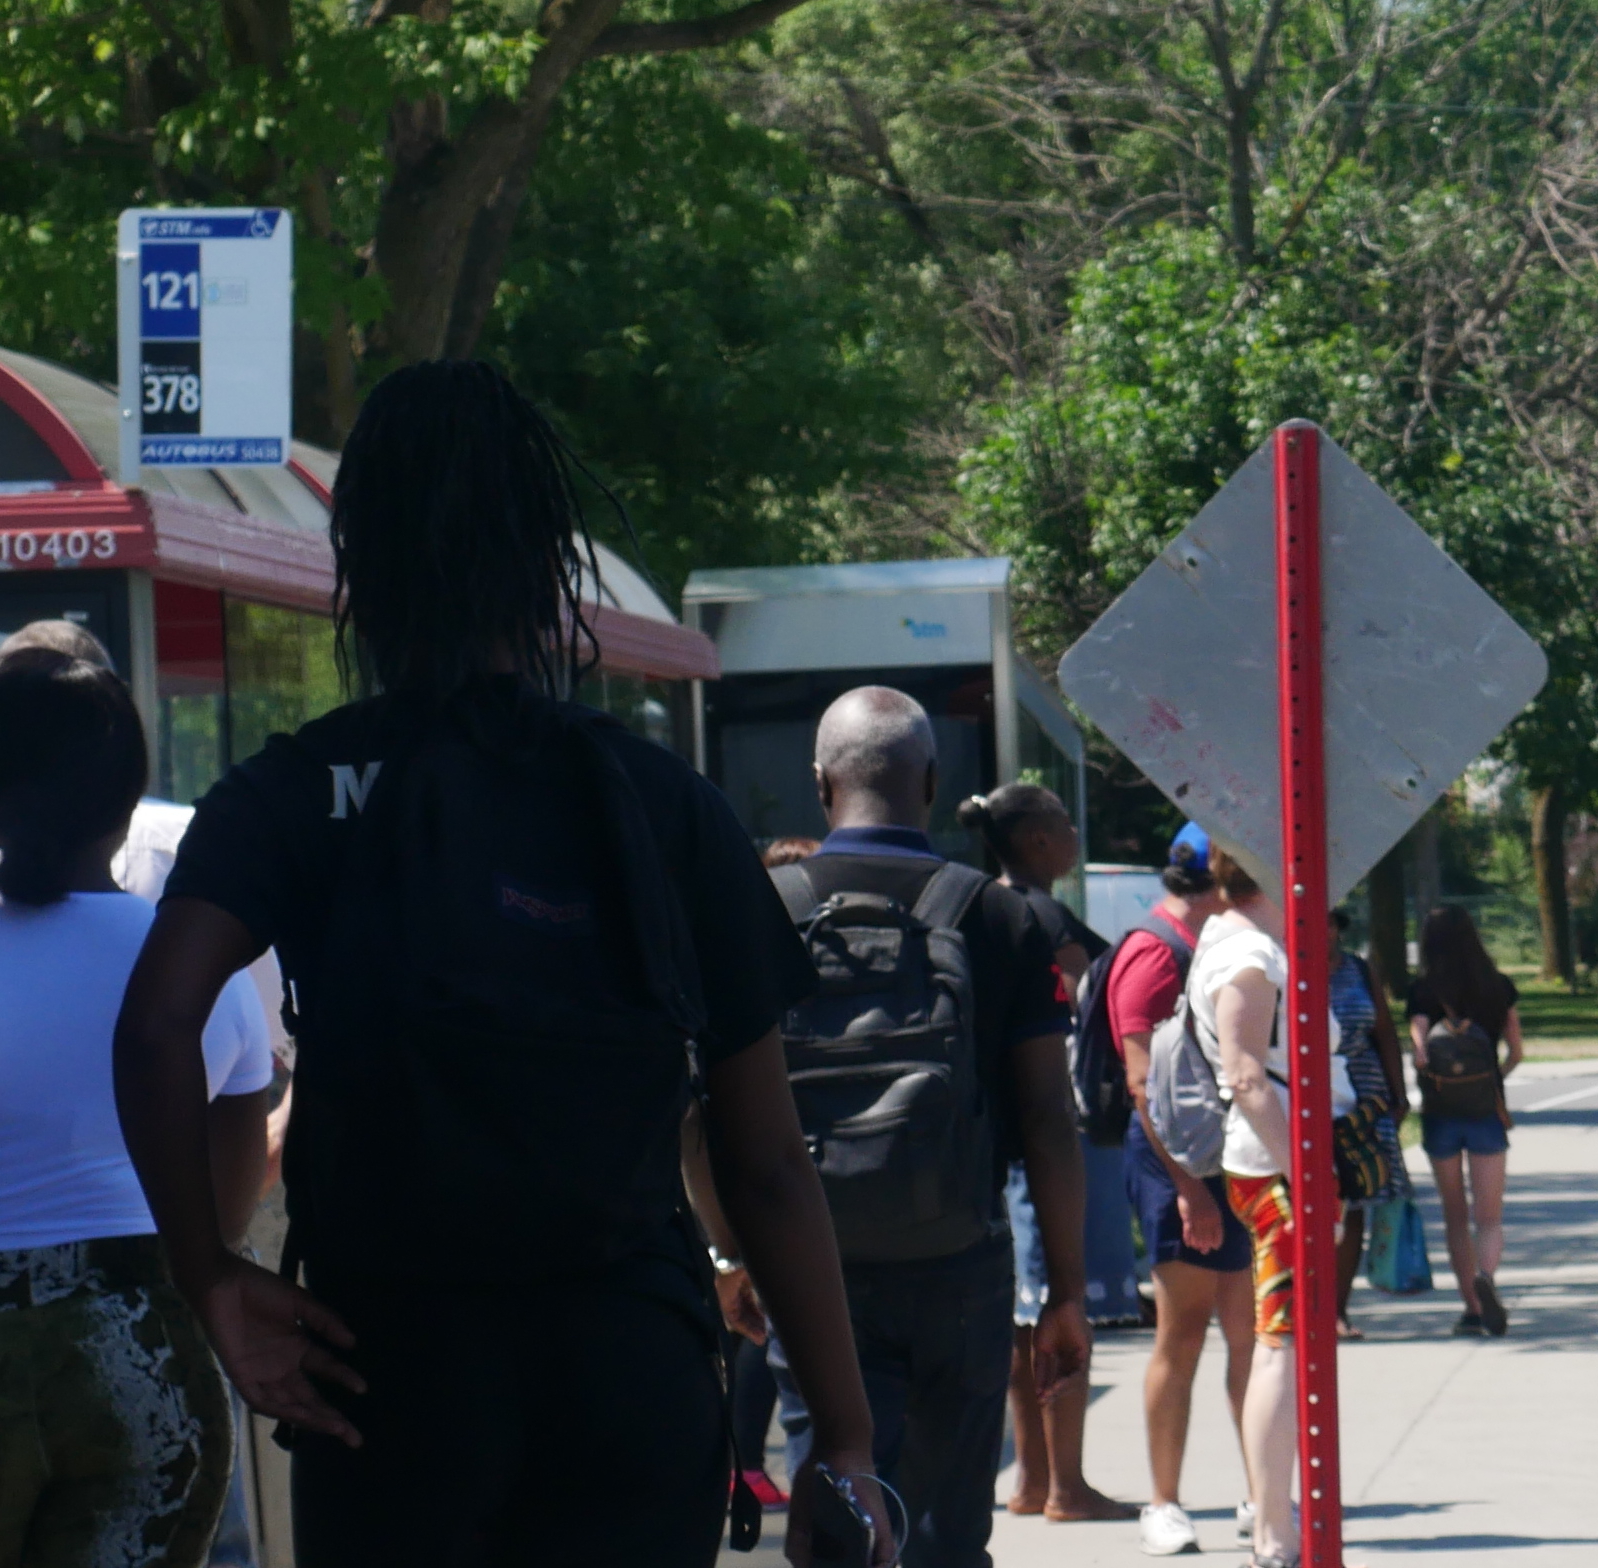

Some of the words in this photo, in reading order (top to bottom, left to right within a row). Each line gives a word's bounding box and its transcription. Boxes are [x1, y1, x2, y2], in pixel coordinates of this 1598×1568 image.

[142, 271, 199, 310] 121
[142, 374, 199, 414] 378
[142, 443, 237, 458] AUTOBUS
[0, 529, 117, 562] 10403
